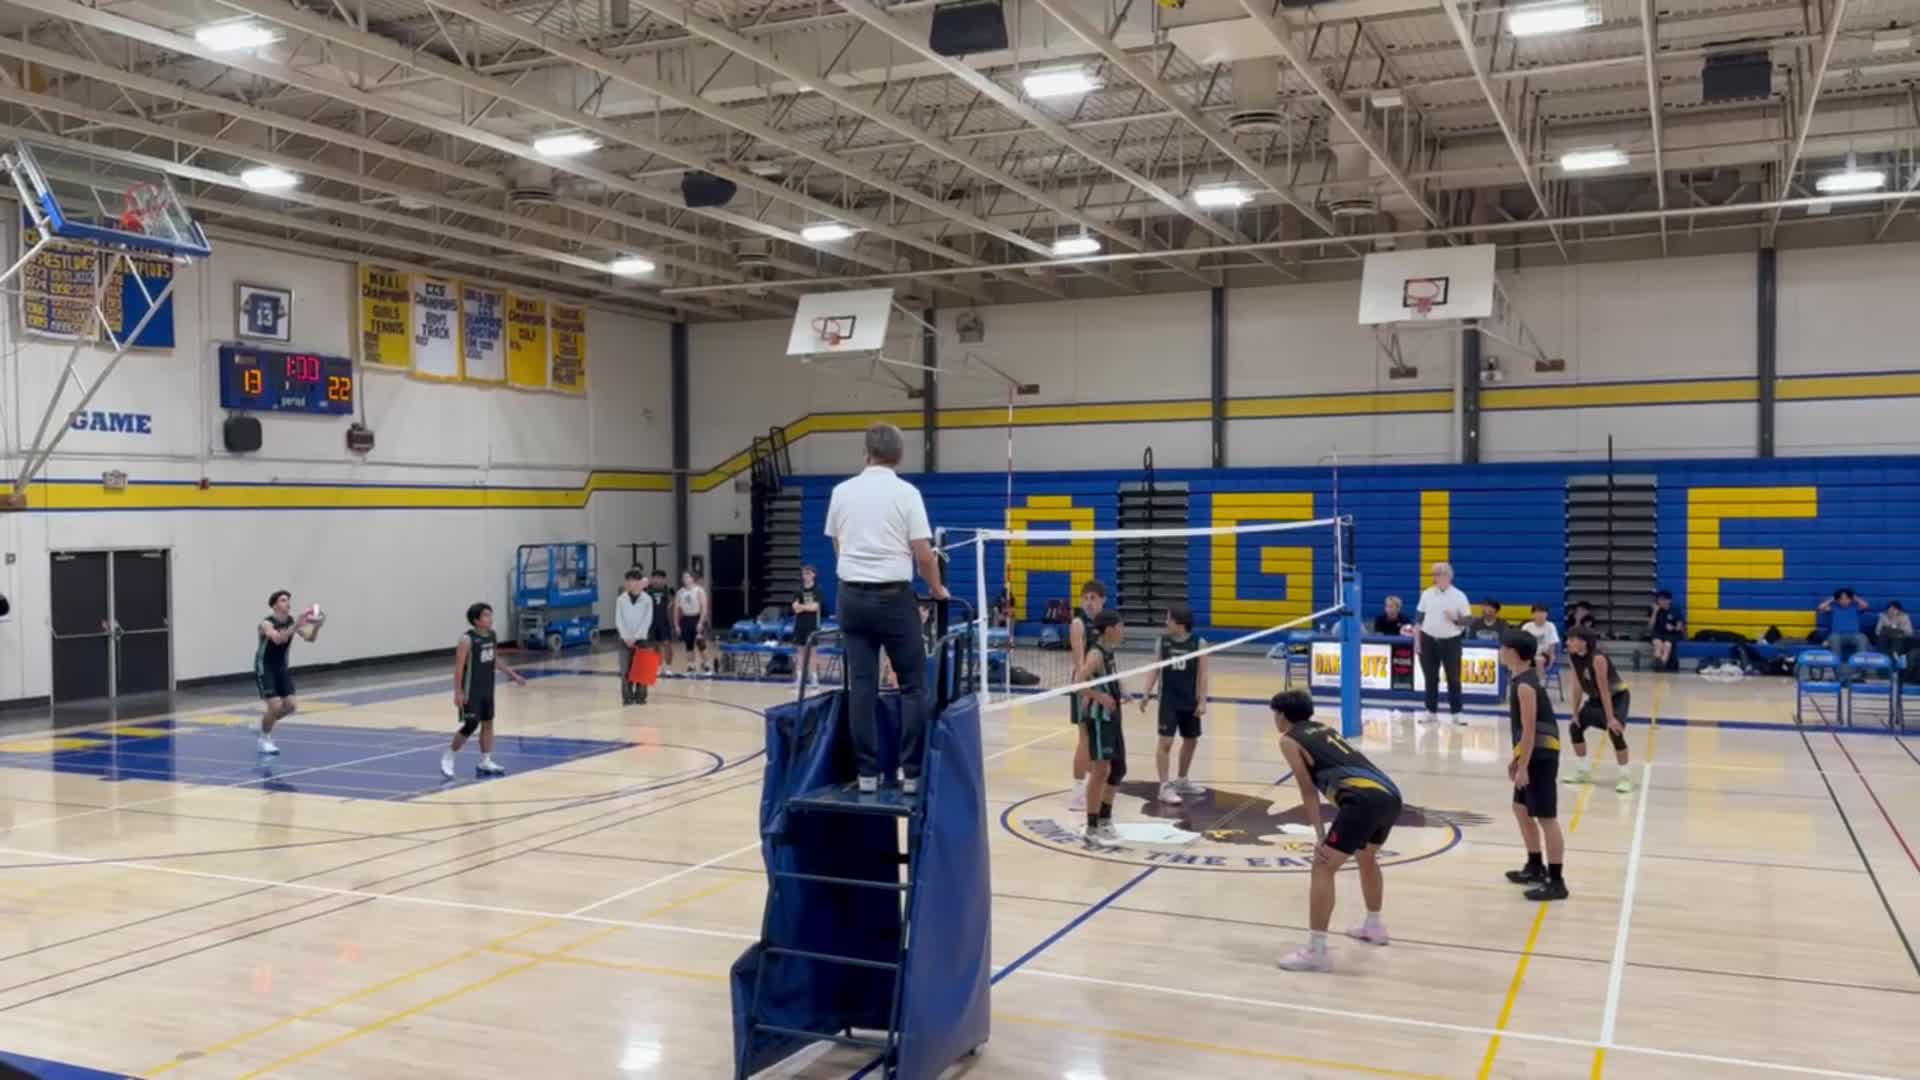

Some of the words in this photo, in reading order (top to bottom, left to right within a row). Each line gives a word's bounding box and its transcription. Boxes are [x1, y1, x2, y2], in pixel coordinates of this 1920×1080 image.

[256, 308, 273, 327] 13
[327, 375, 352, 401] 22
[70, 410, 152, 434] GAME
[1144, 850, 1227, 867] THE
